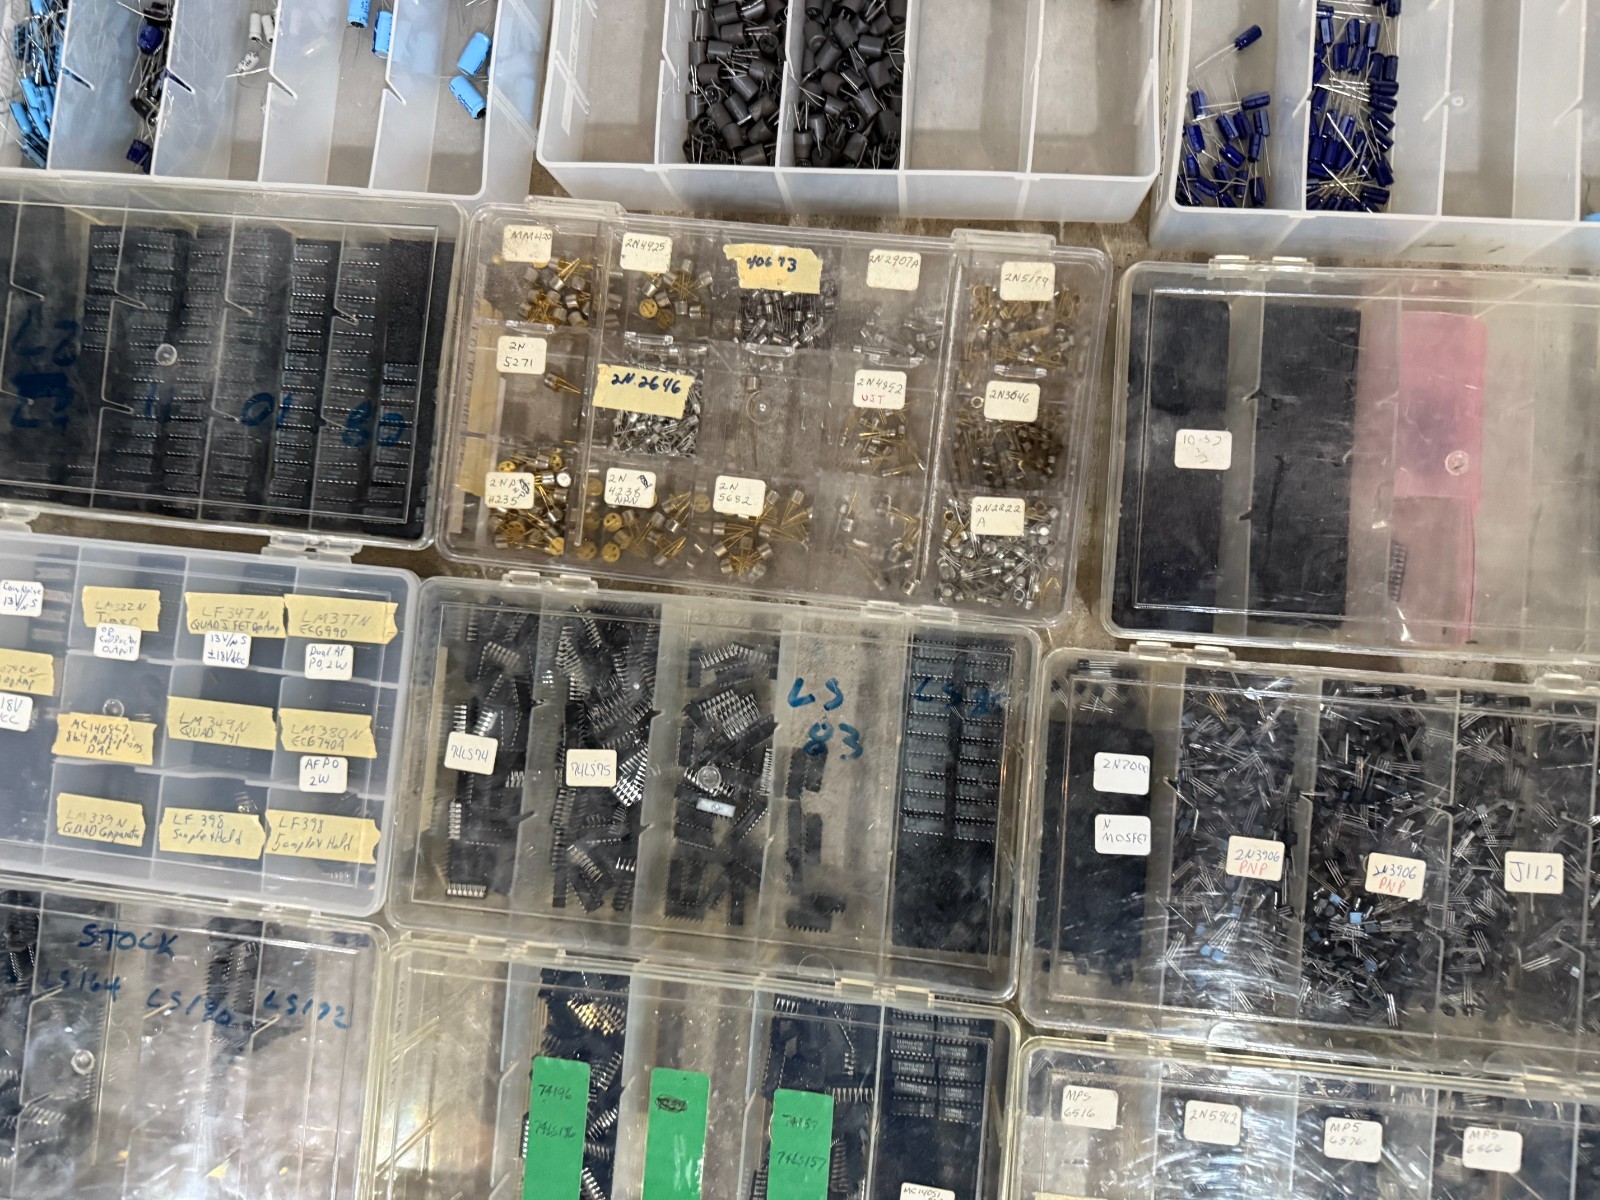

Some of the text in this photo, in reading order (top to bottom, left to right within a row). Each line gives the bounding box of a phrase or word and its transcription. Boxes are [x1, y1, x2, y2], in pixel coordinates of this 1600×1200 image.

[869, 254, 919, 268] 2N2907A
[1004, 272, 1049, 287] 2N5179
[509, 341, 526, 351] 2N
[503, 357, 534, 369] 5271
[861, 394, 885, 403] UJT
[608, 475, 628, 483] 2N
[719, 482, 739, 491] 2N
[977, 516, 986, 528] A
[179, 727, 214, 739] QUAD
[450, 746, 490, 763] 74LS74
[570, 762, 611, 778] 74LS75
[1103, 818, 1112, 829] N
[1234, 849, 1281, 862] 2N3906
[1238, 858, 1269, 874] PNP
[1509, 860, 1559, 883] J112
[1378, 879, 1406, 894] PNP
[77, 923, 179, 958] STOCK
[1065, 1089, 1092, 1102] MPS
[1063, 1107, 1096, 1118] 6516
